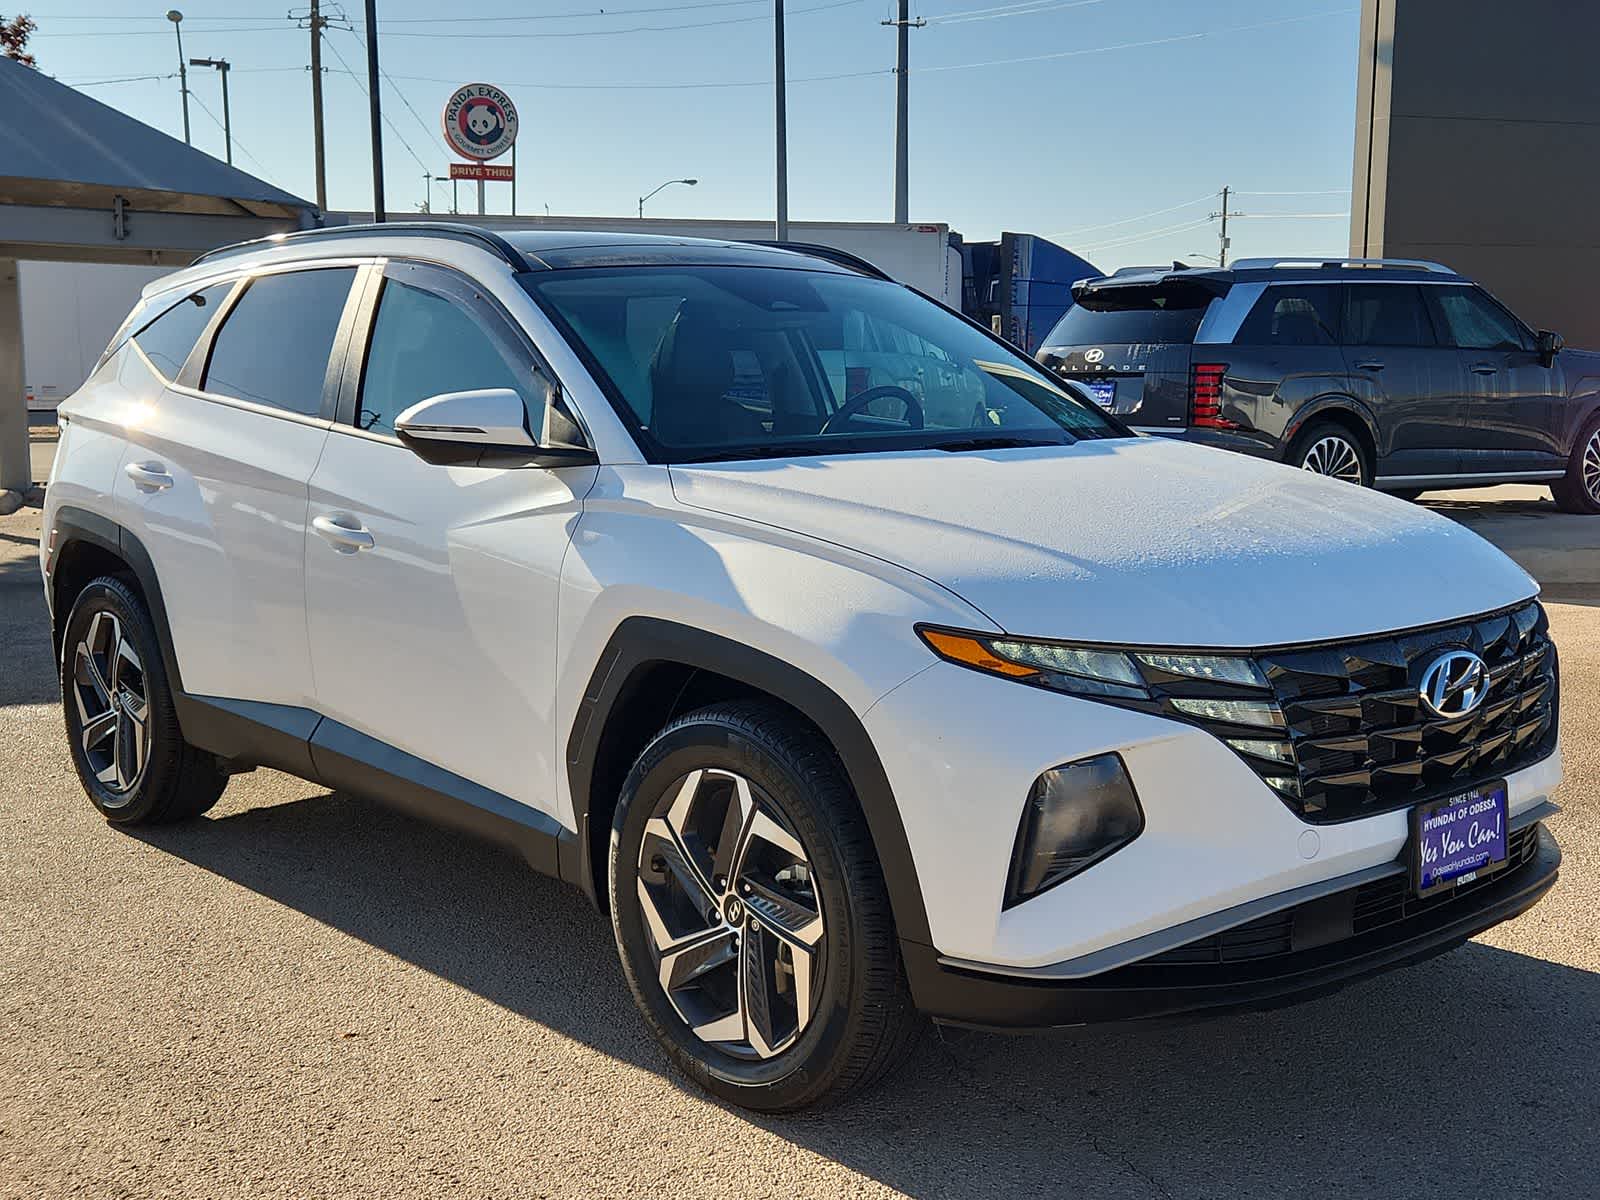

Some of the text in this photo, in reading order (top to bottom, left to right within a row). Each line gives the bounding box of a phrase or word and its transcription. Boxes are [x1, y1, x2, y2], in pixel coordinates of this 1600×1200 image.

[448, 87, 515, 122] PANDA EXPRESS
[452, 167, 513, 177] DRIVE THRU
[1424, 798, 1496, 832] HYUNDAI OF ODESSA
[1448, 793, 1466, 806] SINCE
[1420, 813, 1500, 867] Yes You Can!
